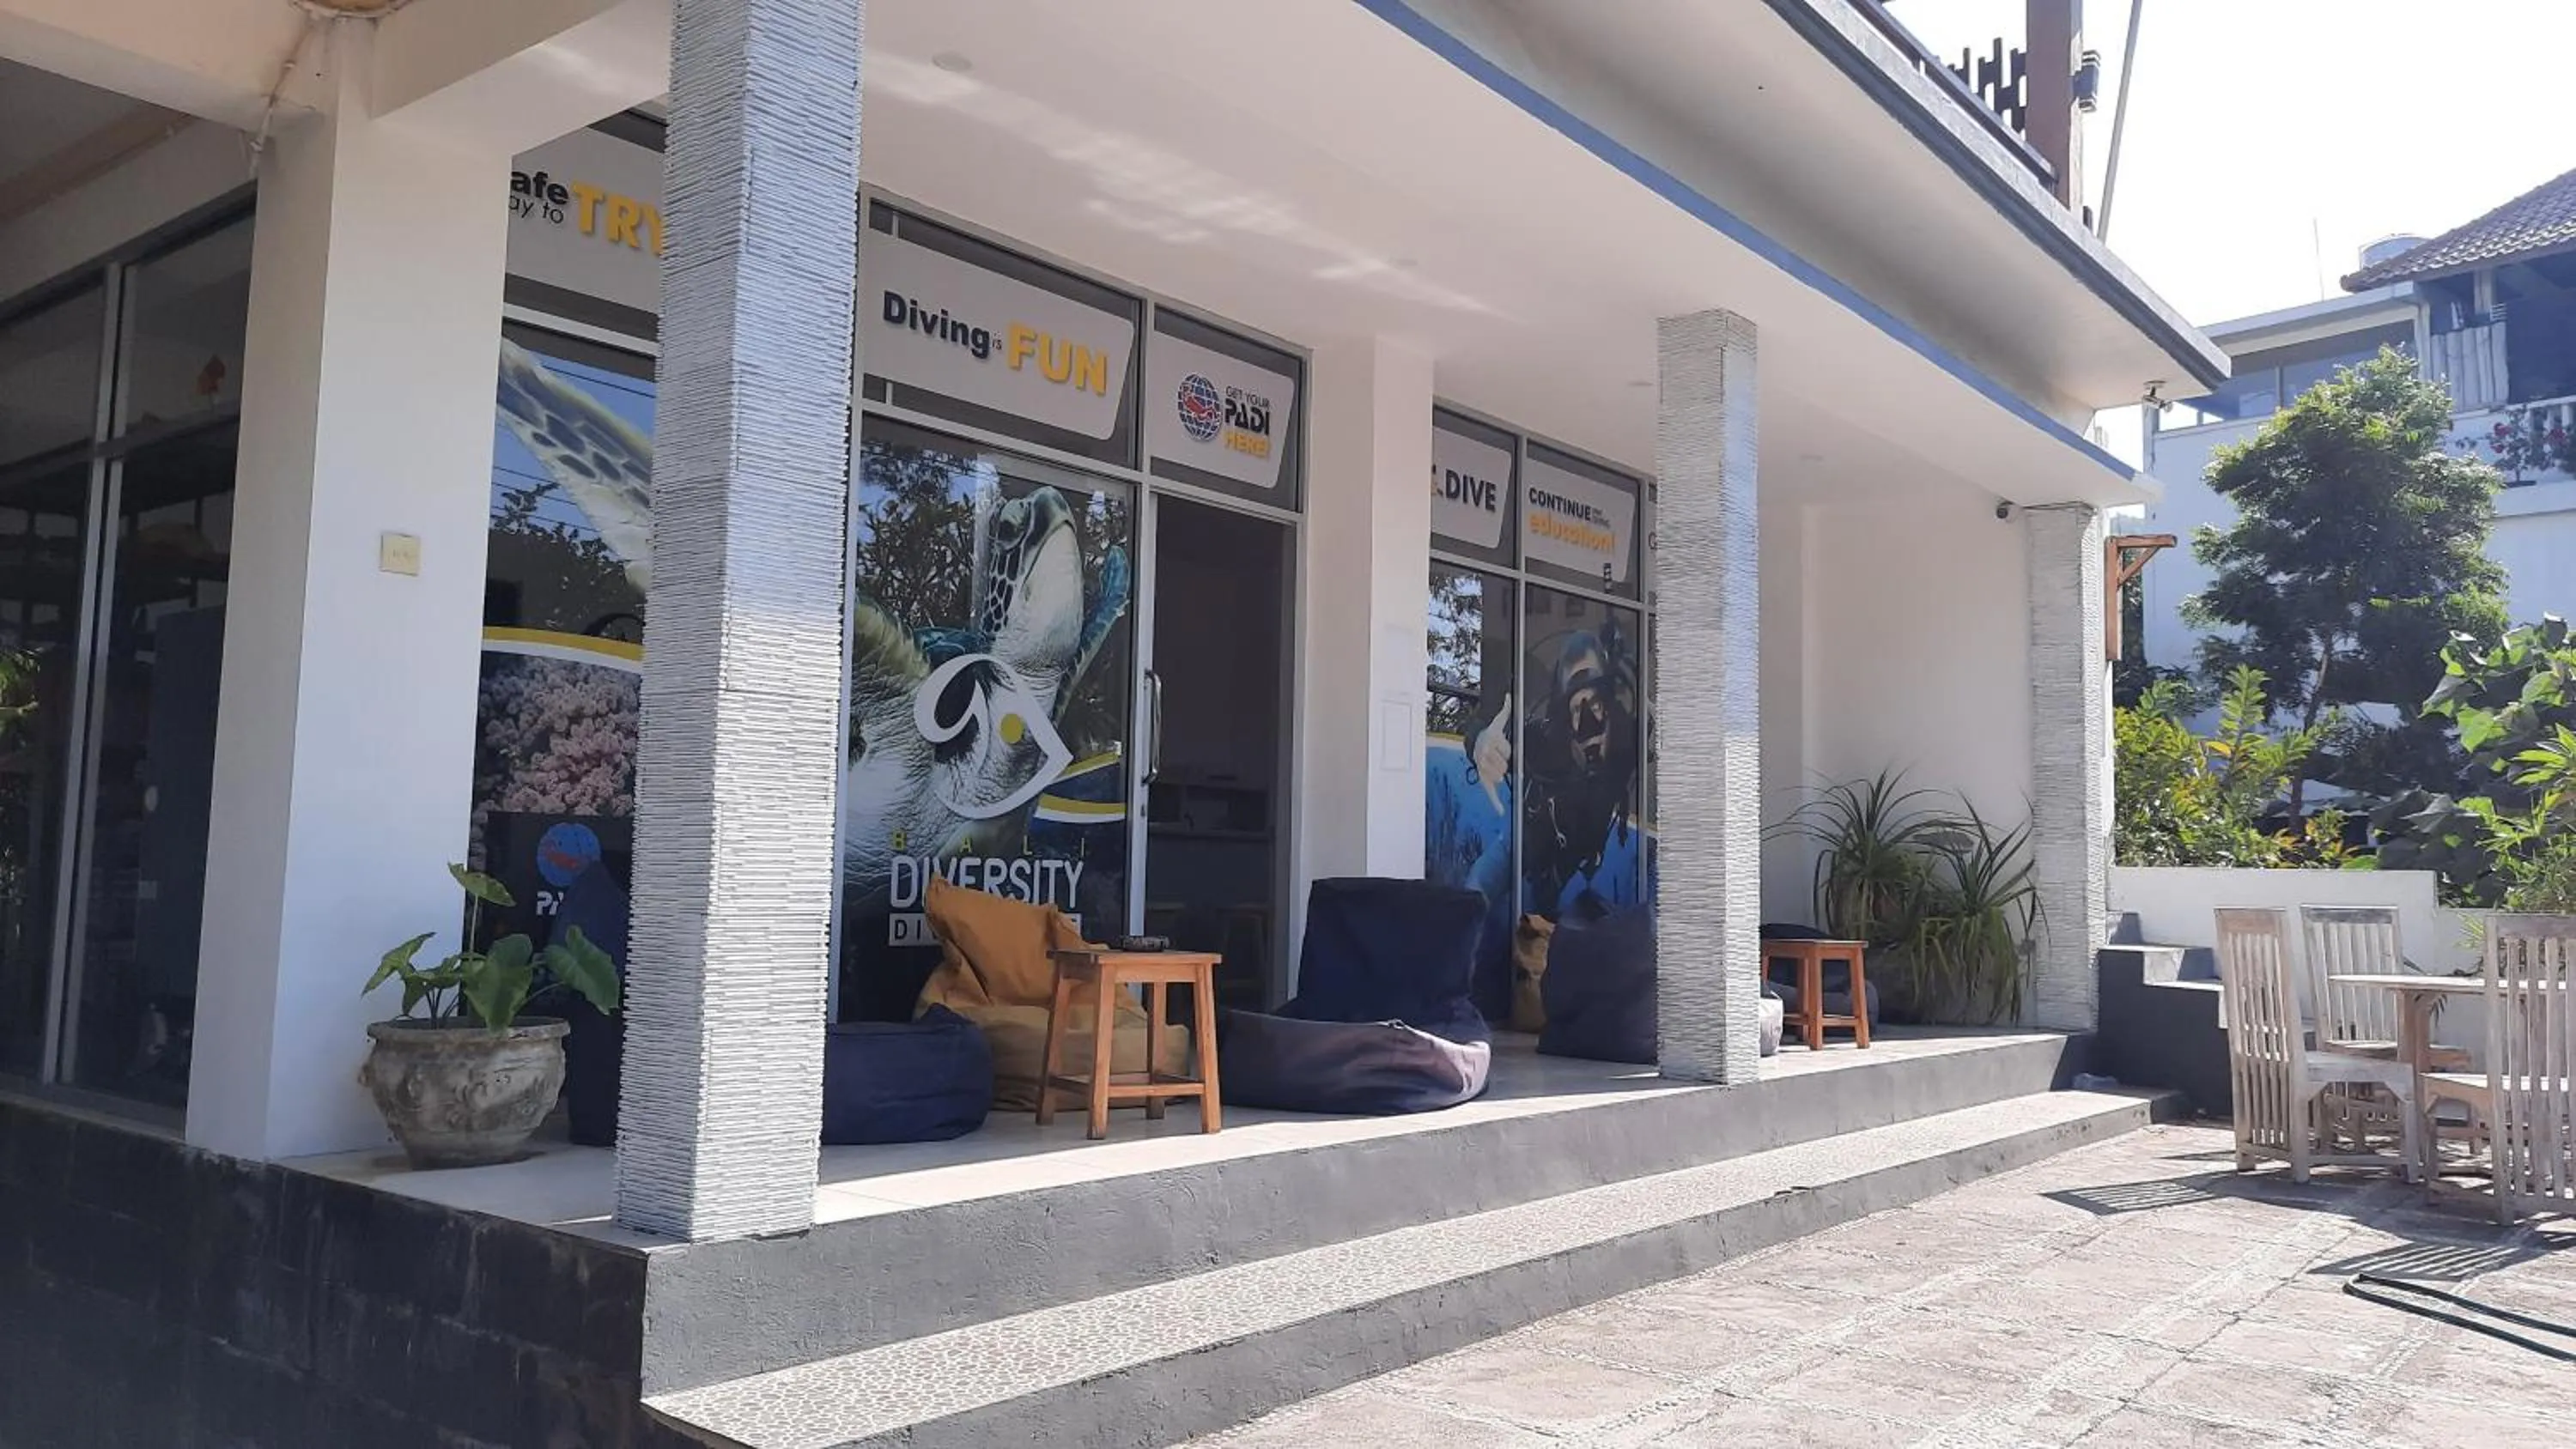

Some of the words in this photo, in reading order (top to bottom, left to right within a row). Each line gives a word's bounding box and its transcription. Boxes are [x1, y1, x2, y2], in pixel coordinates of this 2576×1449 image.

[543, 202, 564, 224] to
[883, 289, 990, 360] Diving
[1008, 321, 1109, 397] FUN
[1225, 397, 1270, 436] PADI
[1246, 393, 1270, 410] YOUR
[1446, 468, 1497, 513] DIVE
[1528, 487, 1592, 522] CONTINUE
